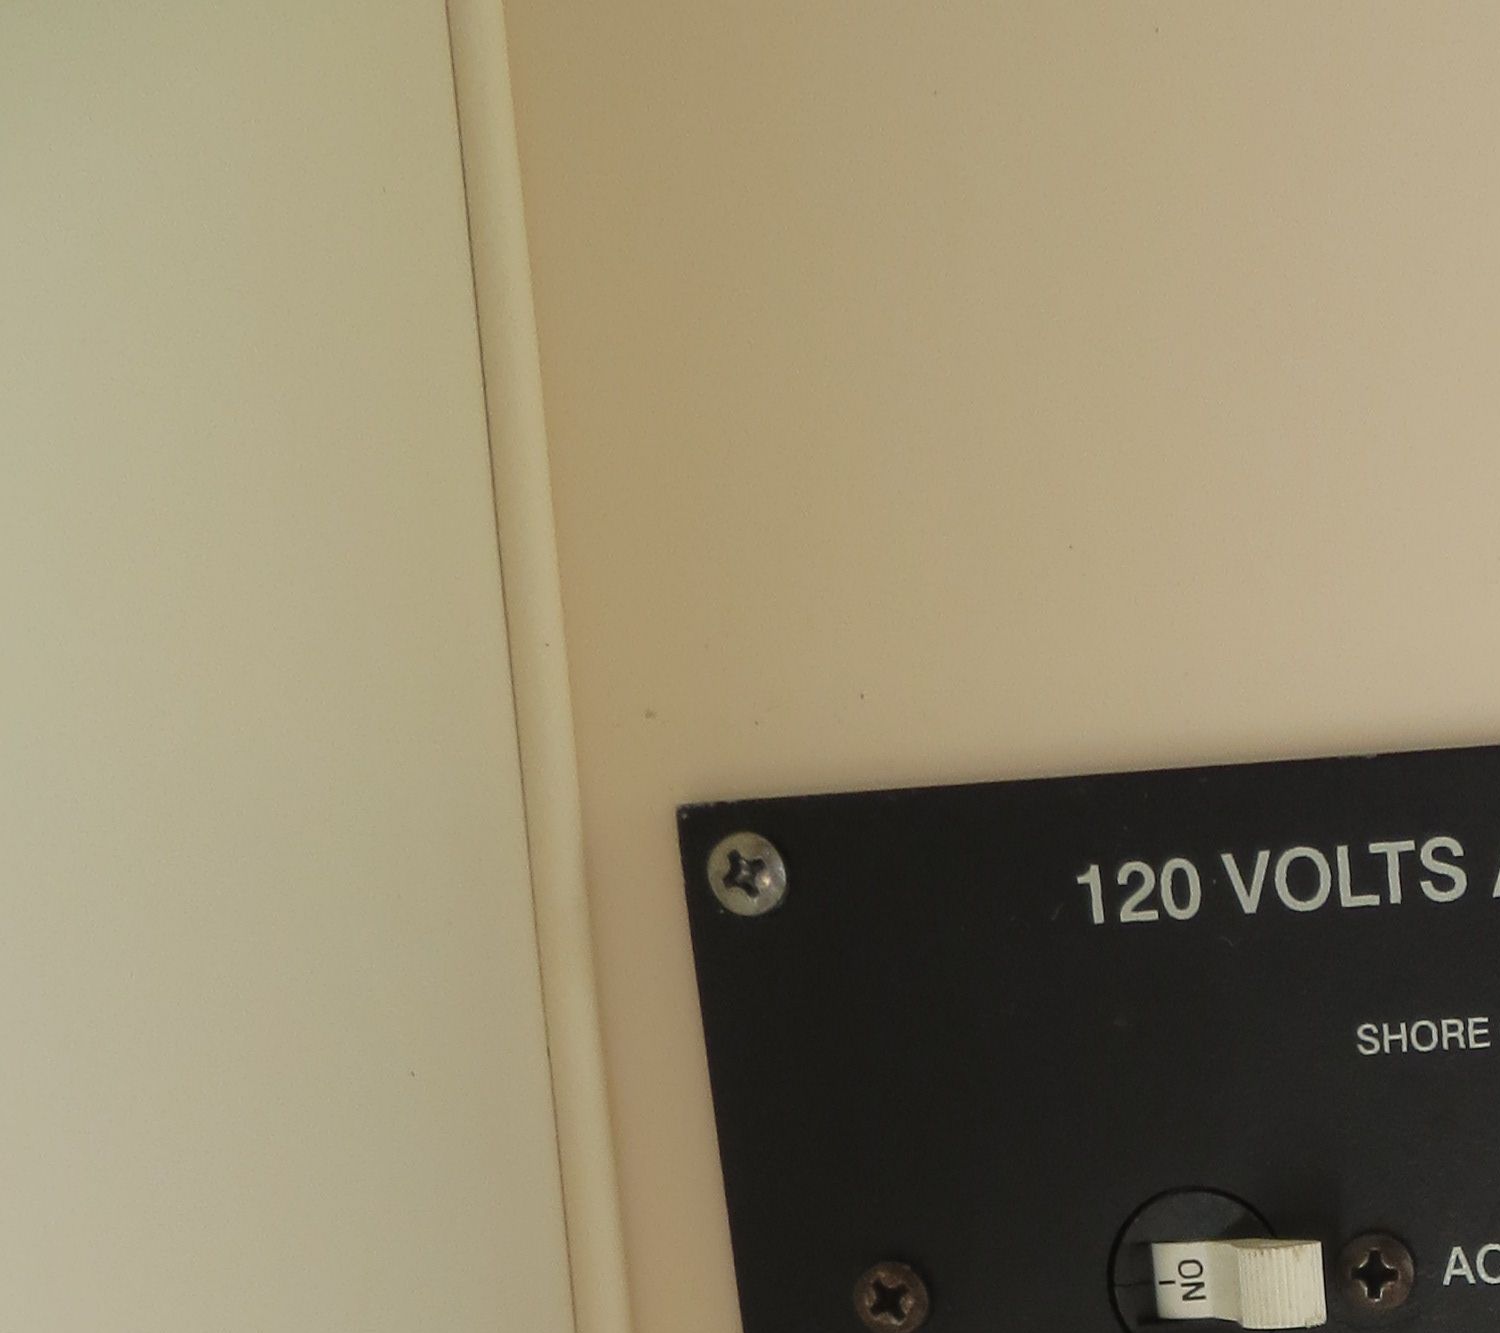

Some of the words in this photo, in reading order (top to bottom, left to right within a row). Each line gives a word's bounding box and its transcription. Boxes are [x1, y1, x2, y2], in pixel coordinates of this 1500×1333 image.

[1076, 857, 1202, 925] 120
[1221, 836, 1468, 914] VOLTS
[1356, 1016, 1491, 1055] SHORE
[1178, 1259, 1206, 1301] ON
